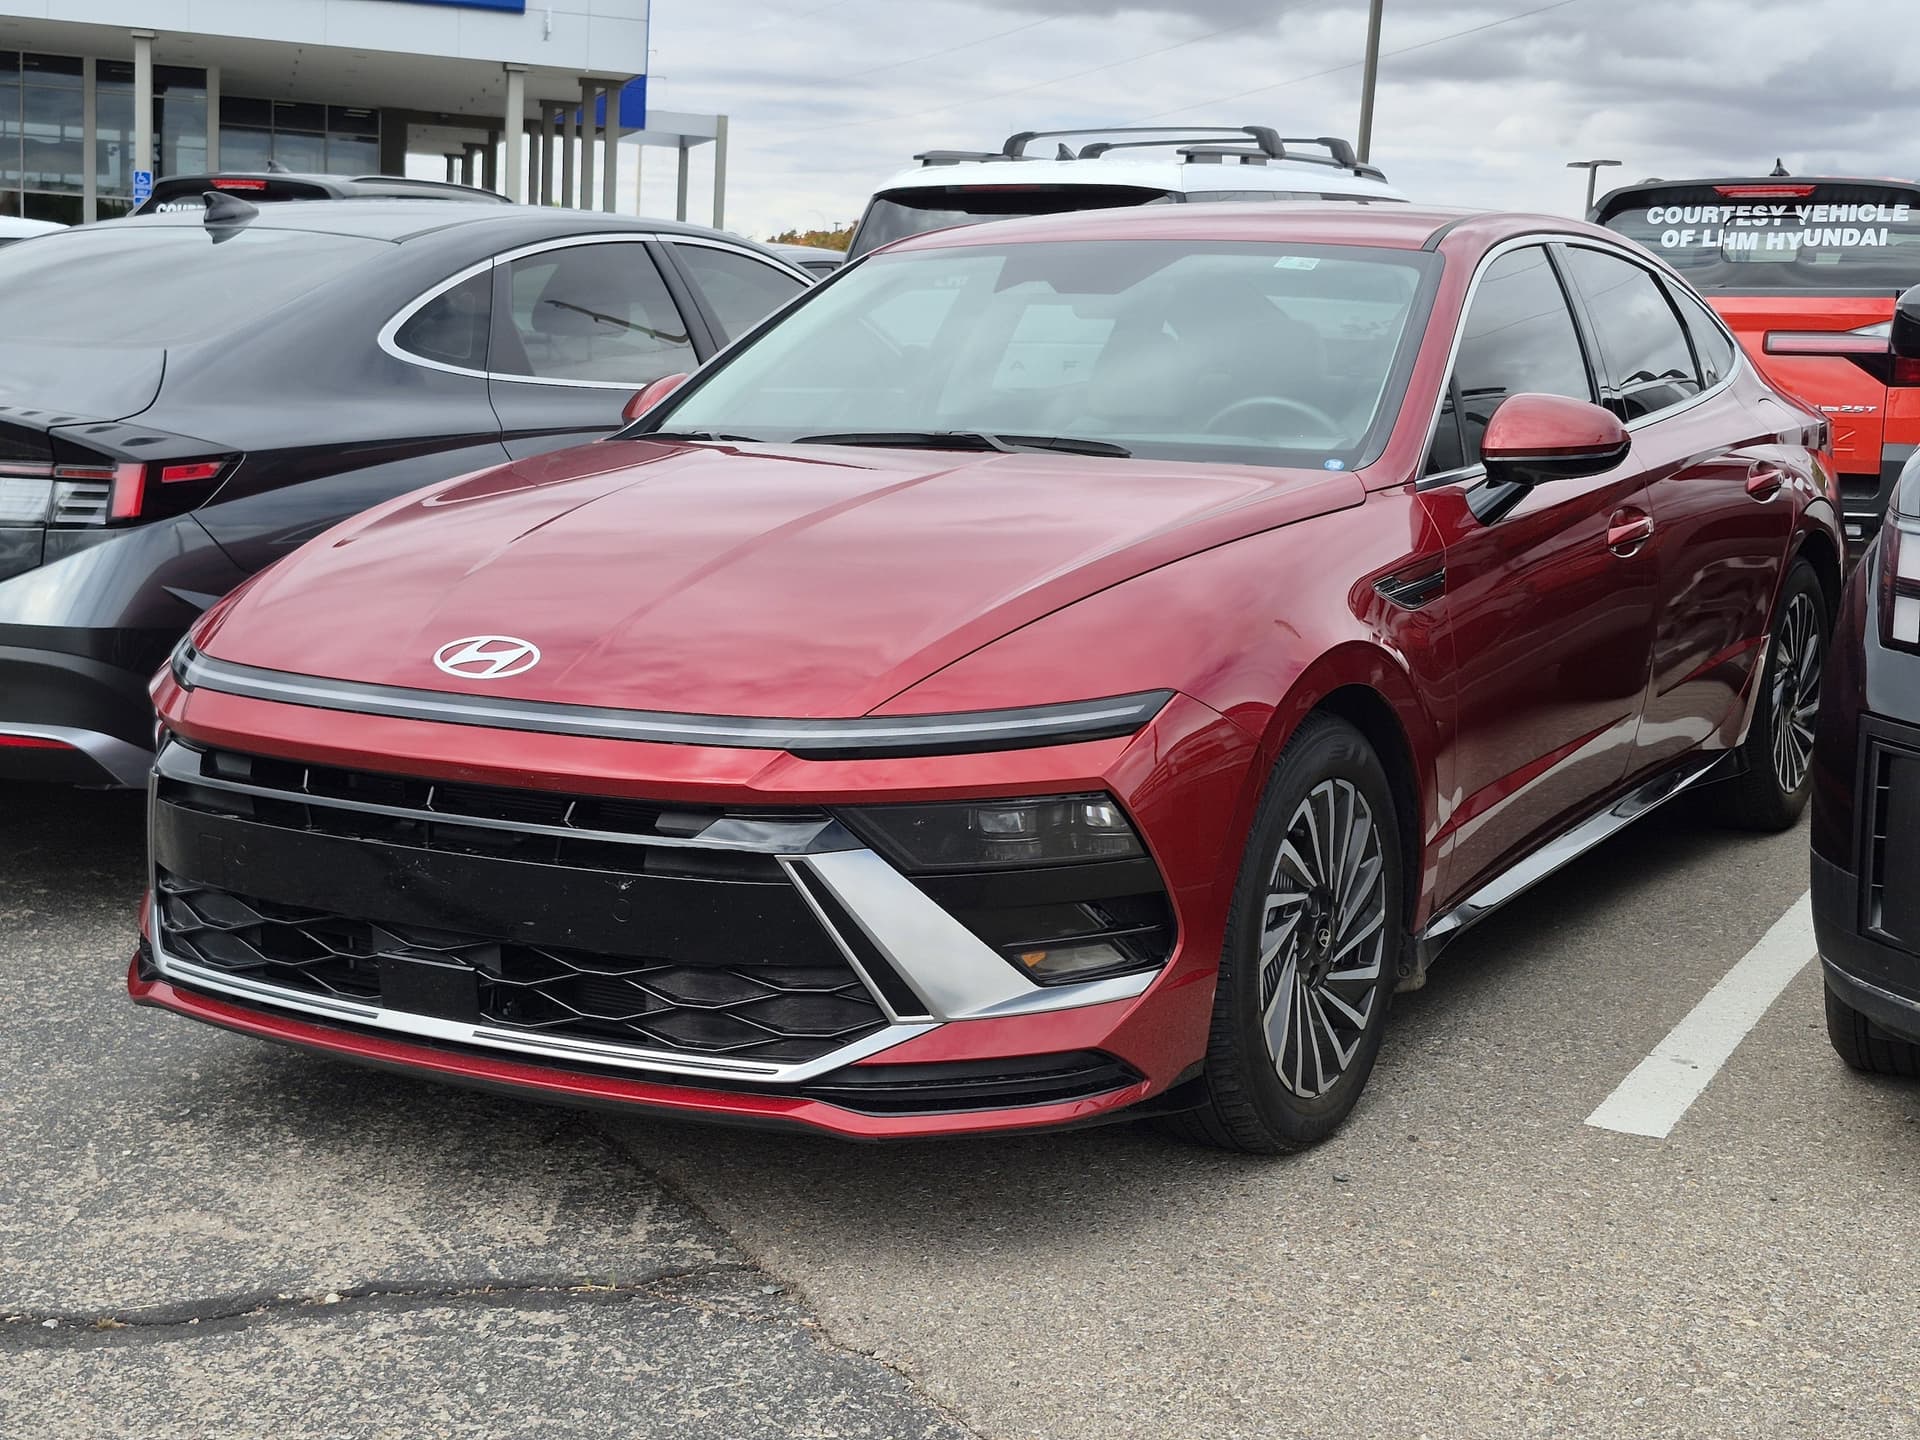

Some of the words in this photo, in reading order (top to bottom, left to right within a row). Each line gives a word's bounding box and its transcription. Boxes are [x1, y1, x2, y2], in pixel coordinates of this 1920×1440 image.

[1646, 205, 1787, 226] COURTESY
[1795, 204, 1910, 226] VEHICLE
[1661, 229, 1696, 248] OF
[1765, 228, 1888, 250] HYUNDAI
